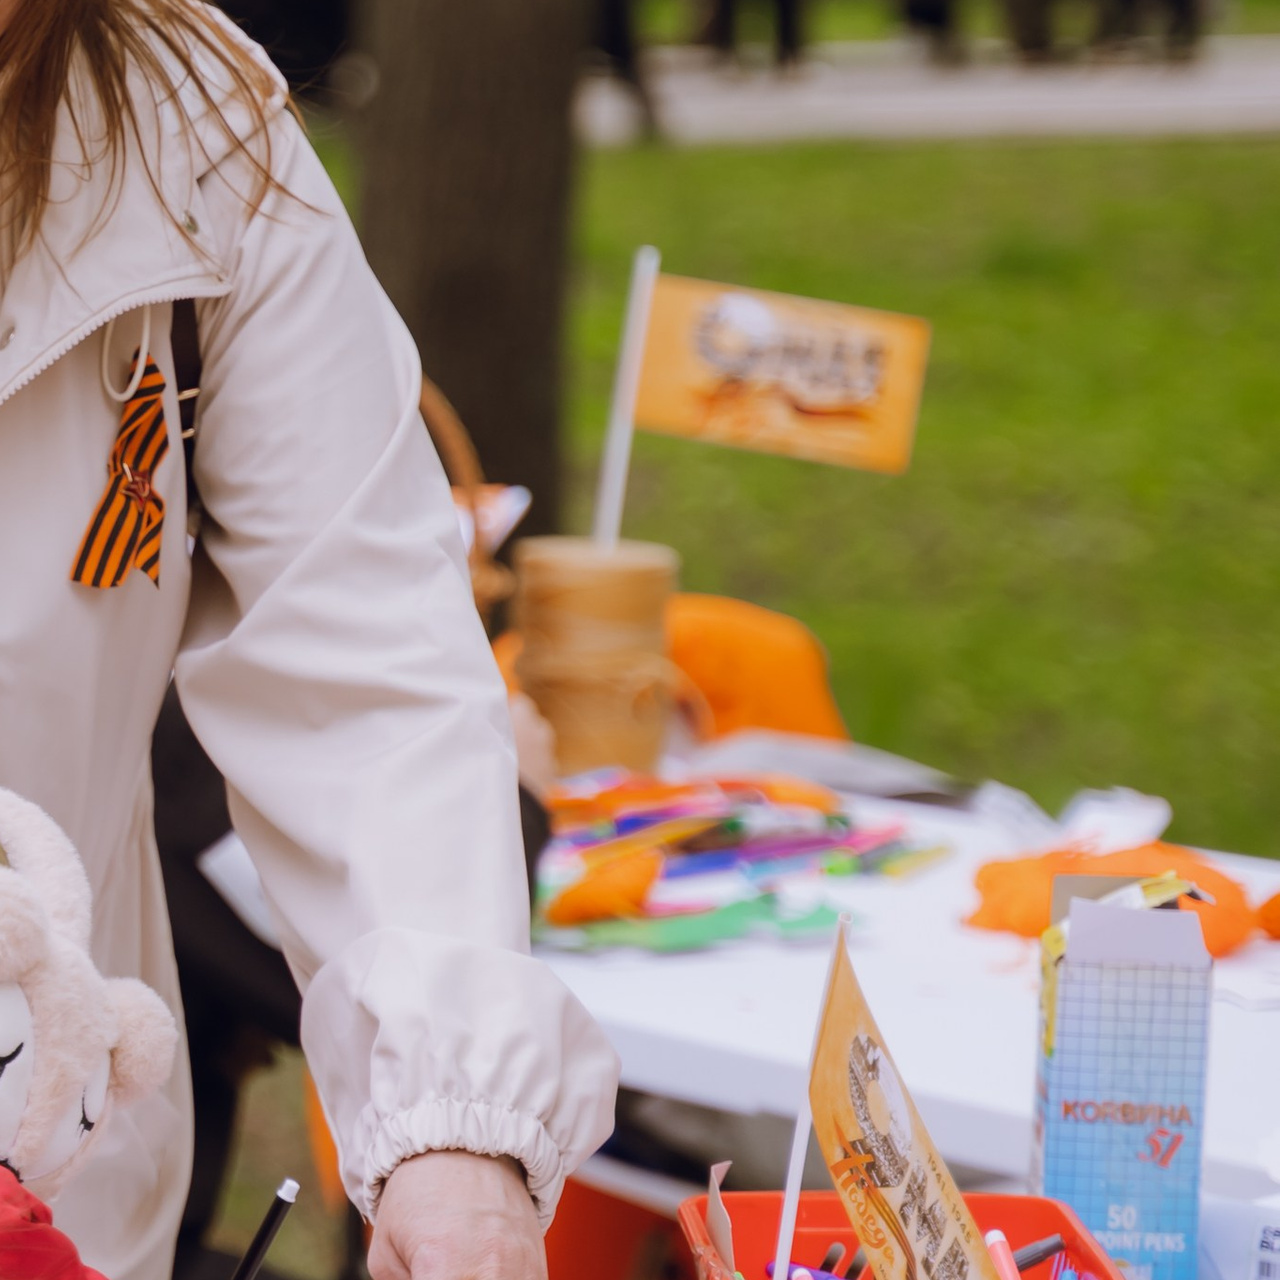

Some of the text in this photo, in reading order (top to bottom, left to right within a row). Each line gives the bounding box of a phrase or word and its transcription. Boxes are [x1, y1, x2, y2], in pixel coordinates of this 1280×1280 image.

[843, 1034, 911, 1188] 9
[1138, 1126, 1185, 1169] 51
[927, 1152, 946, 1192] 1941
[951, 1202, 972, 1244] 1945
[1107, 1205, 1138, 1230] 50
[1144, 1232, 1187, 1253] PENS
